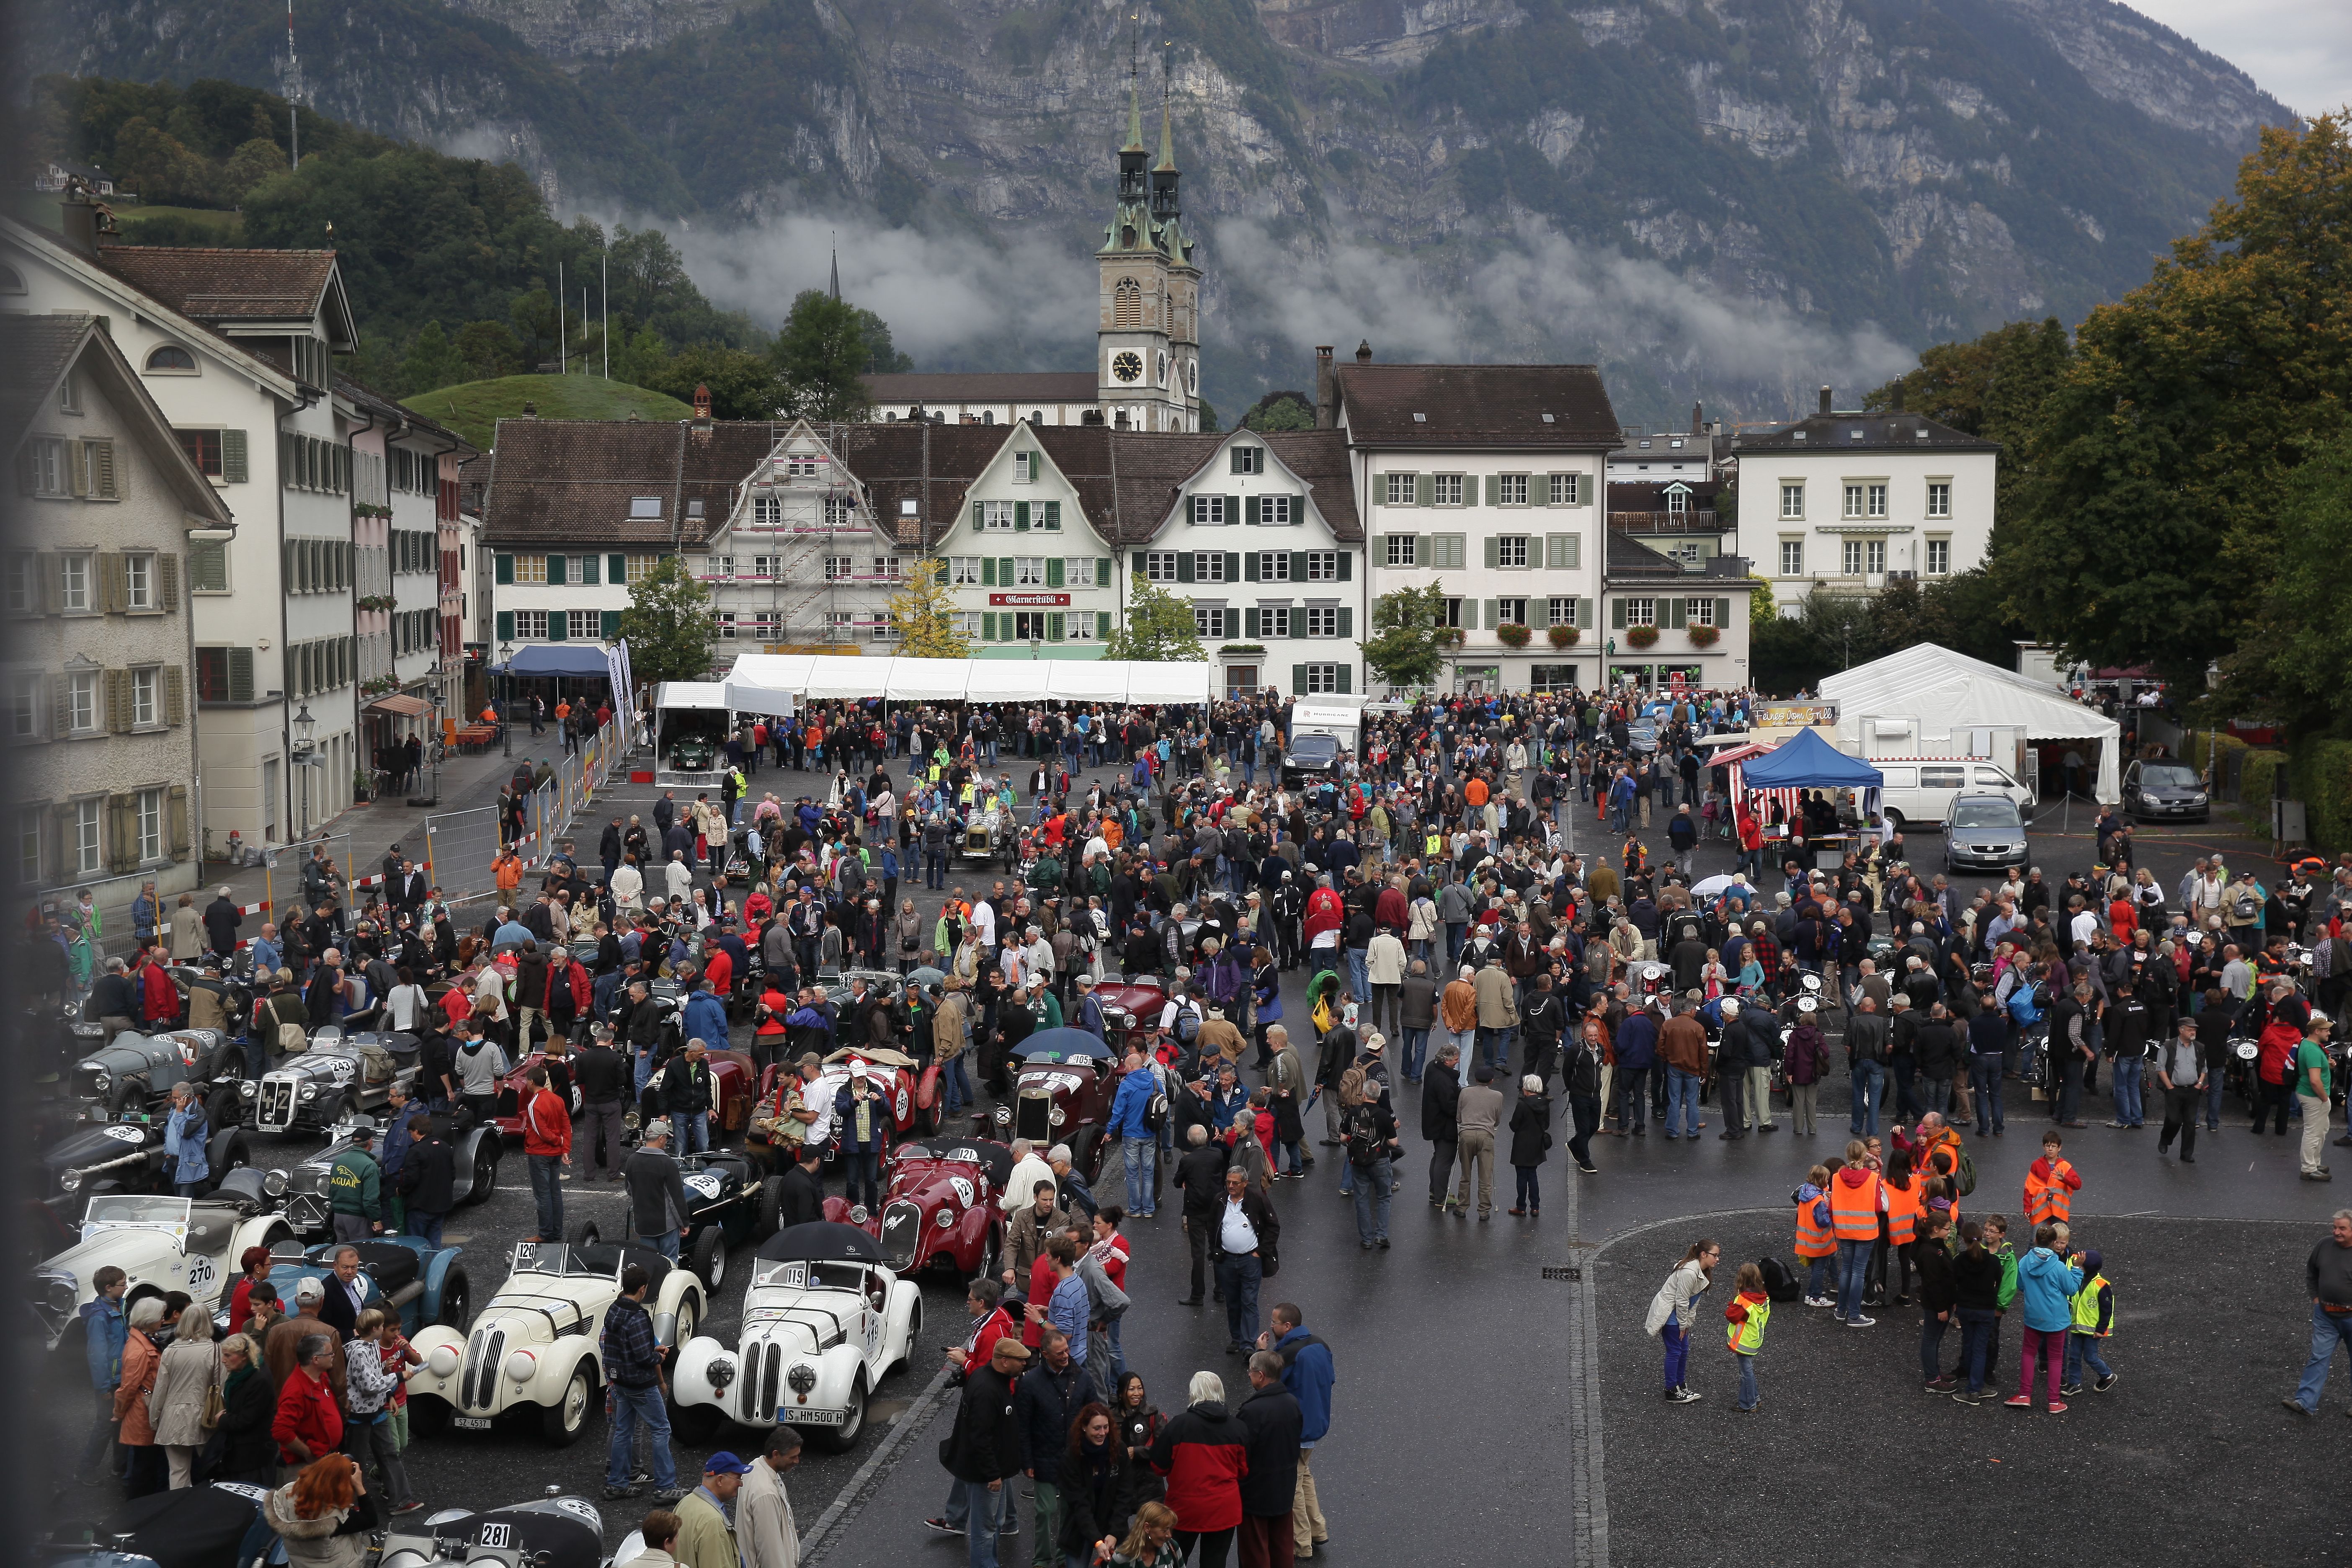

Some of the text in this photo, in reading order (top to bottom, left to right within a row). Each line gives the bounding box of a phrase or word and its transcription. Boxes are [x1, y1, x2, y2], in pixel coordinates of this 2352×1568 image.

[1752, 710, 1785, 720] Feines
[1806, 708, 1832, 720] Grill
[330, 1061, 351, 1072] 243
[1075, 1055, 1088, 1065] 105
[897, 1097, 907, 1112] 260
[112, 1127, 138, 1139] 284
[959, 1149, 972, 1160] 121
[694, 1176, 716, 1189] 150
[957, 1185, 973, 1199] 121
[520, 1244, 534, 1258] 120
[190, 1265, 211, 1285] 270
[788, 1269, 803, 1284] 119
[867, 1324, 879, 1346] 119
[836, 1413, 842, 1423] H
[576, 1501, 598, 1522] 281
[482, 1525, 510, 1546] 281
